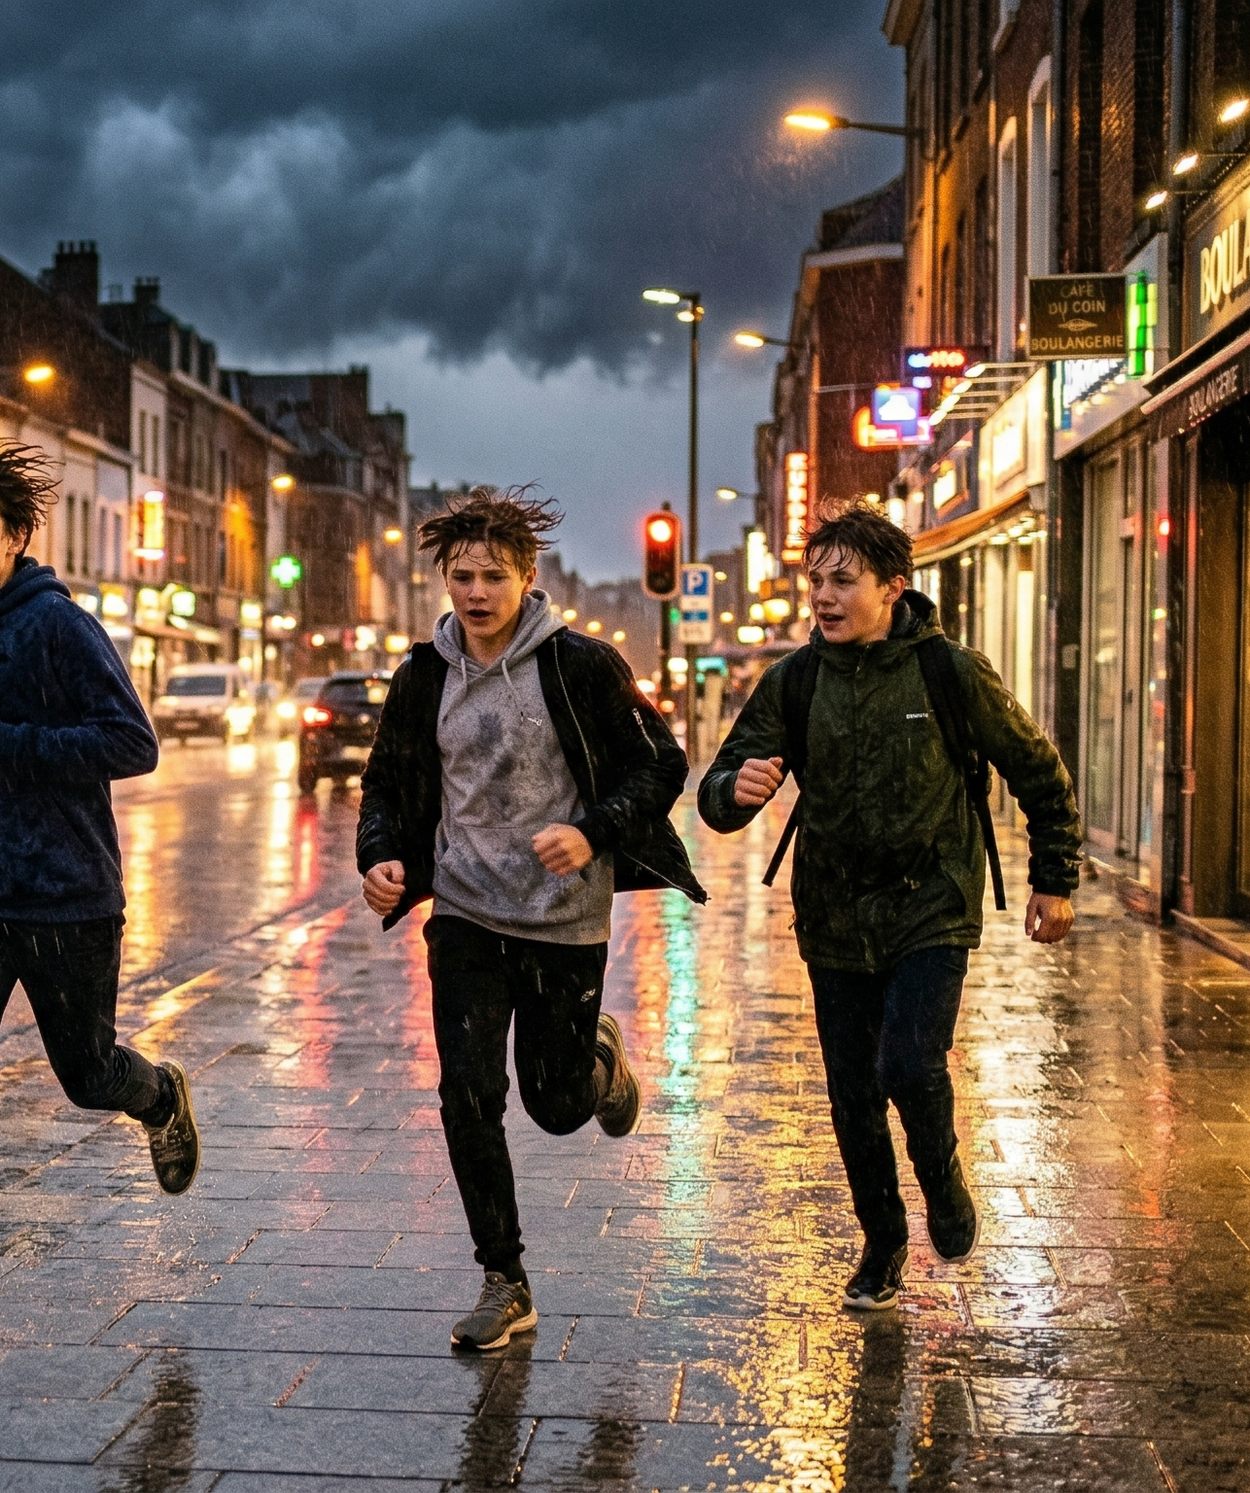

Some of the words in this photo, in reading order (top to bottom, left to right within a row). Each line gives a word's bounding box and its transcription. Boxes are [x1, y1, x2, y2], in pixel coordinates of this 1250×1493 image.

[1049, 301, 1068, 315] DU
[1072, 300, 1106, 313] COIN
[1031, 335, 1124, 351] BOULANGERIE
[687, 571, 703, 593] P
